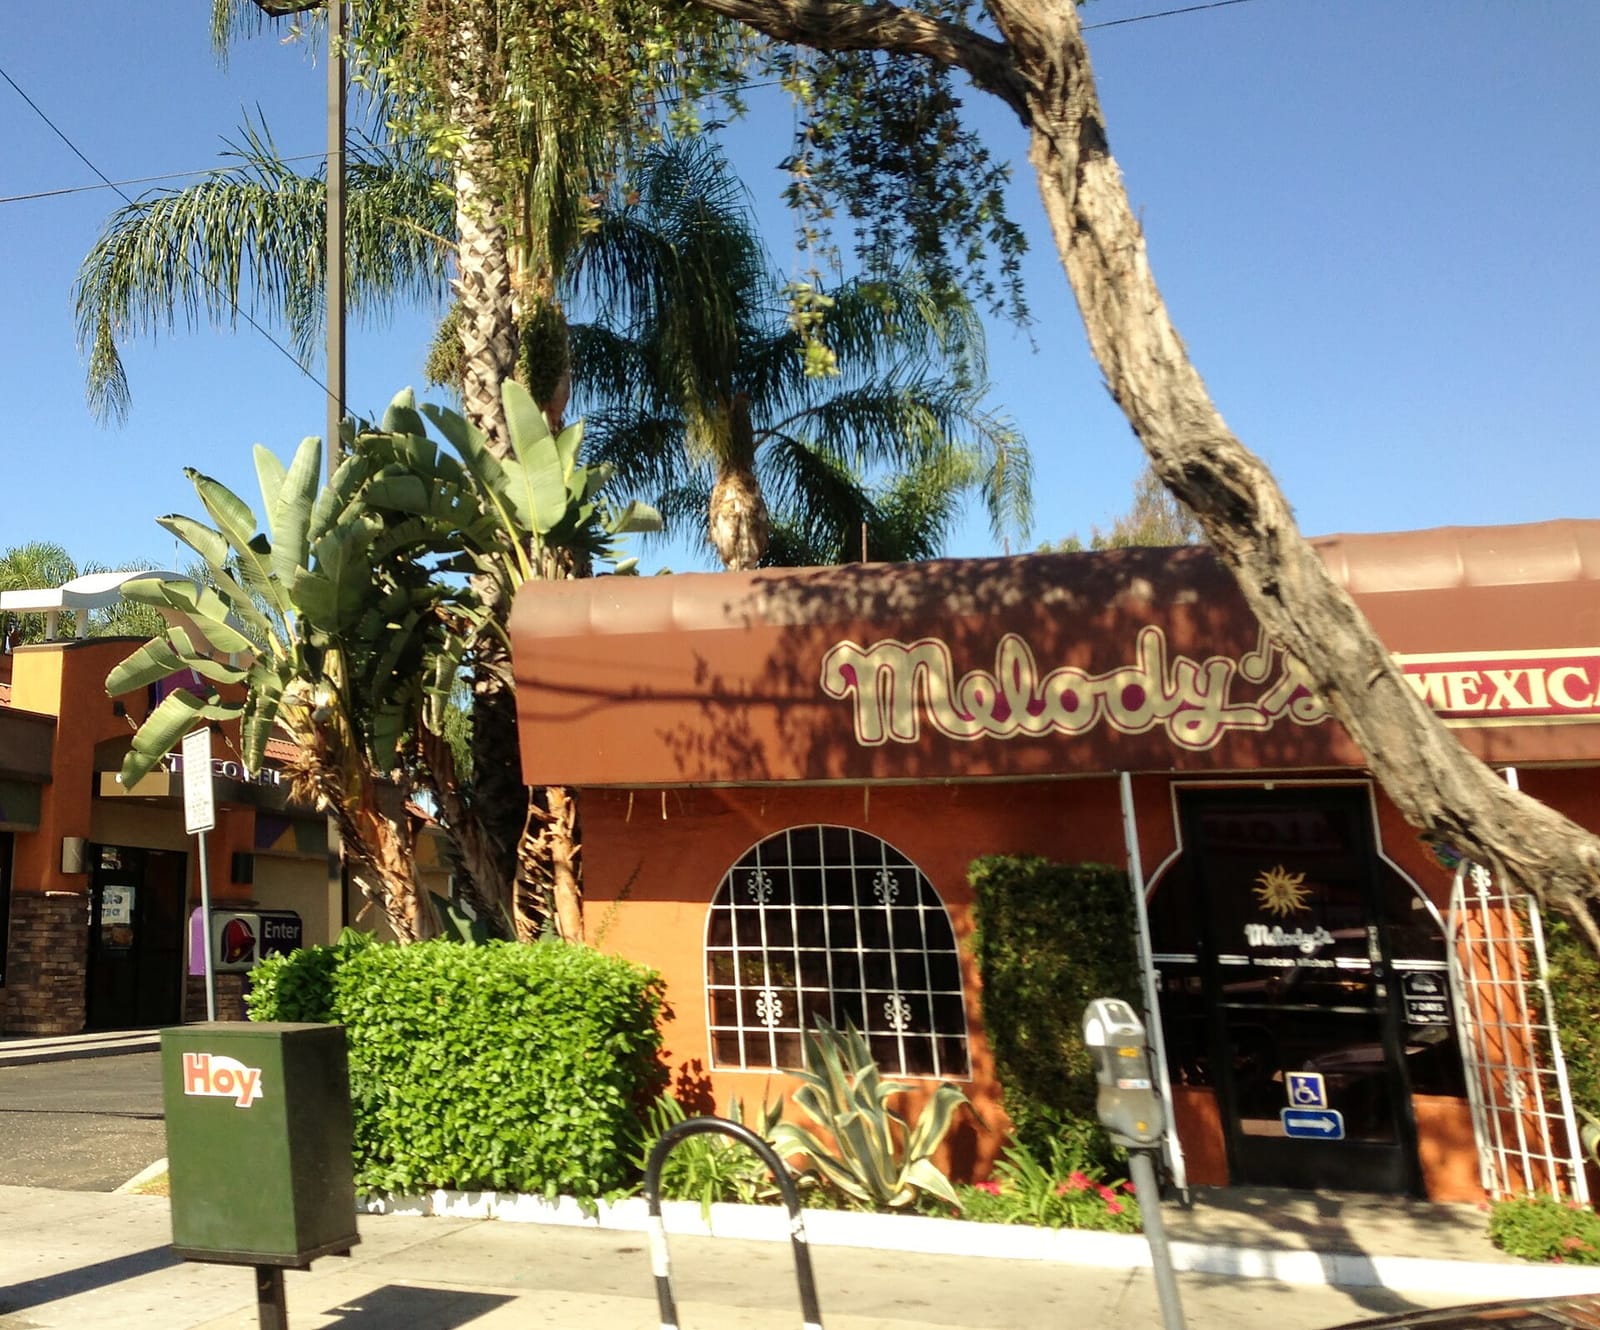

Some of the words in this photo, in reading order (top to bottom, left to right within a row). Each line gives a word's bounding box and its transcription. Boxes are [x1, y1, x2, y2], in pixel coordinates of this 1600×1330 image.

[1403, 666, 1600, 711] MEXIC
[264, 921, 300, 939] Enter
[184, 1054, 261, 1107] Hoy
